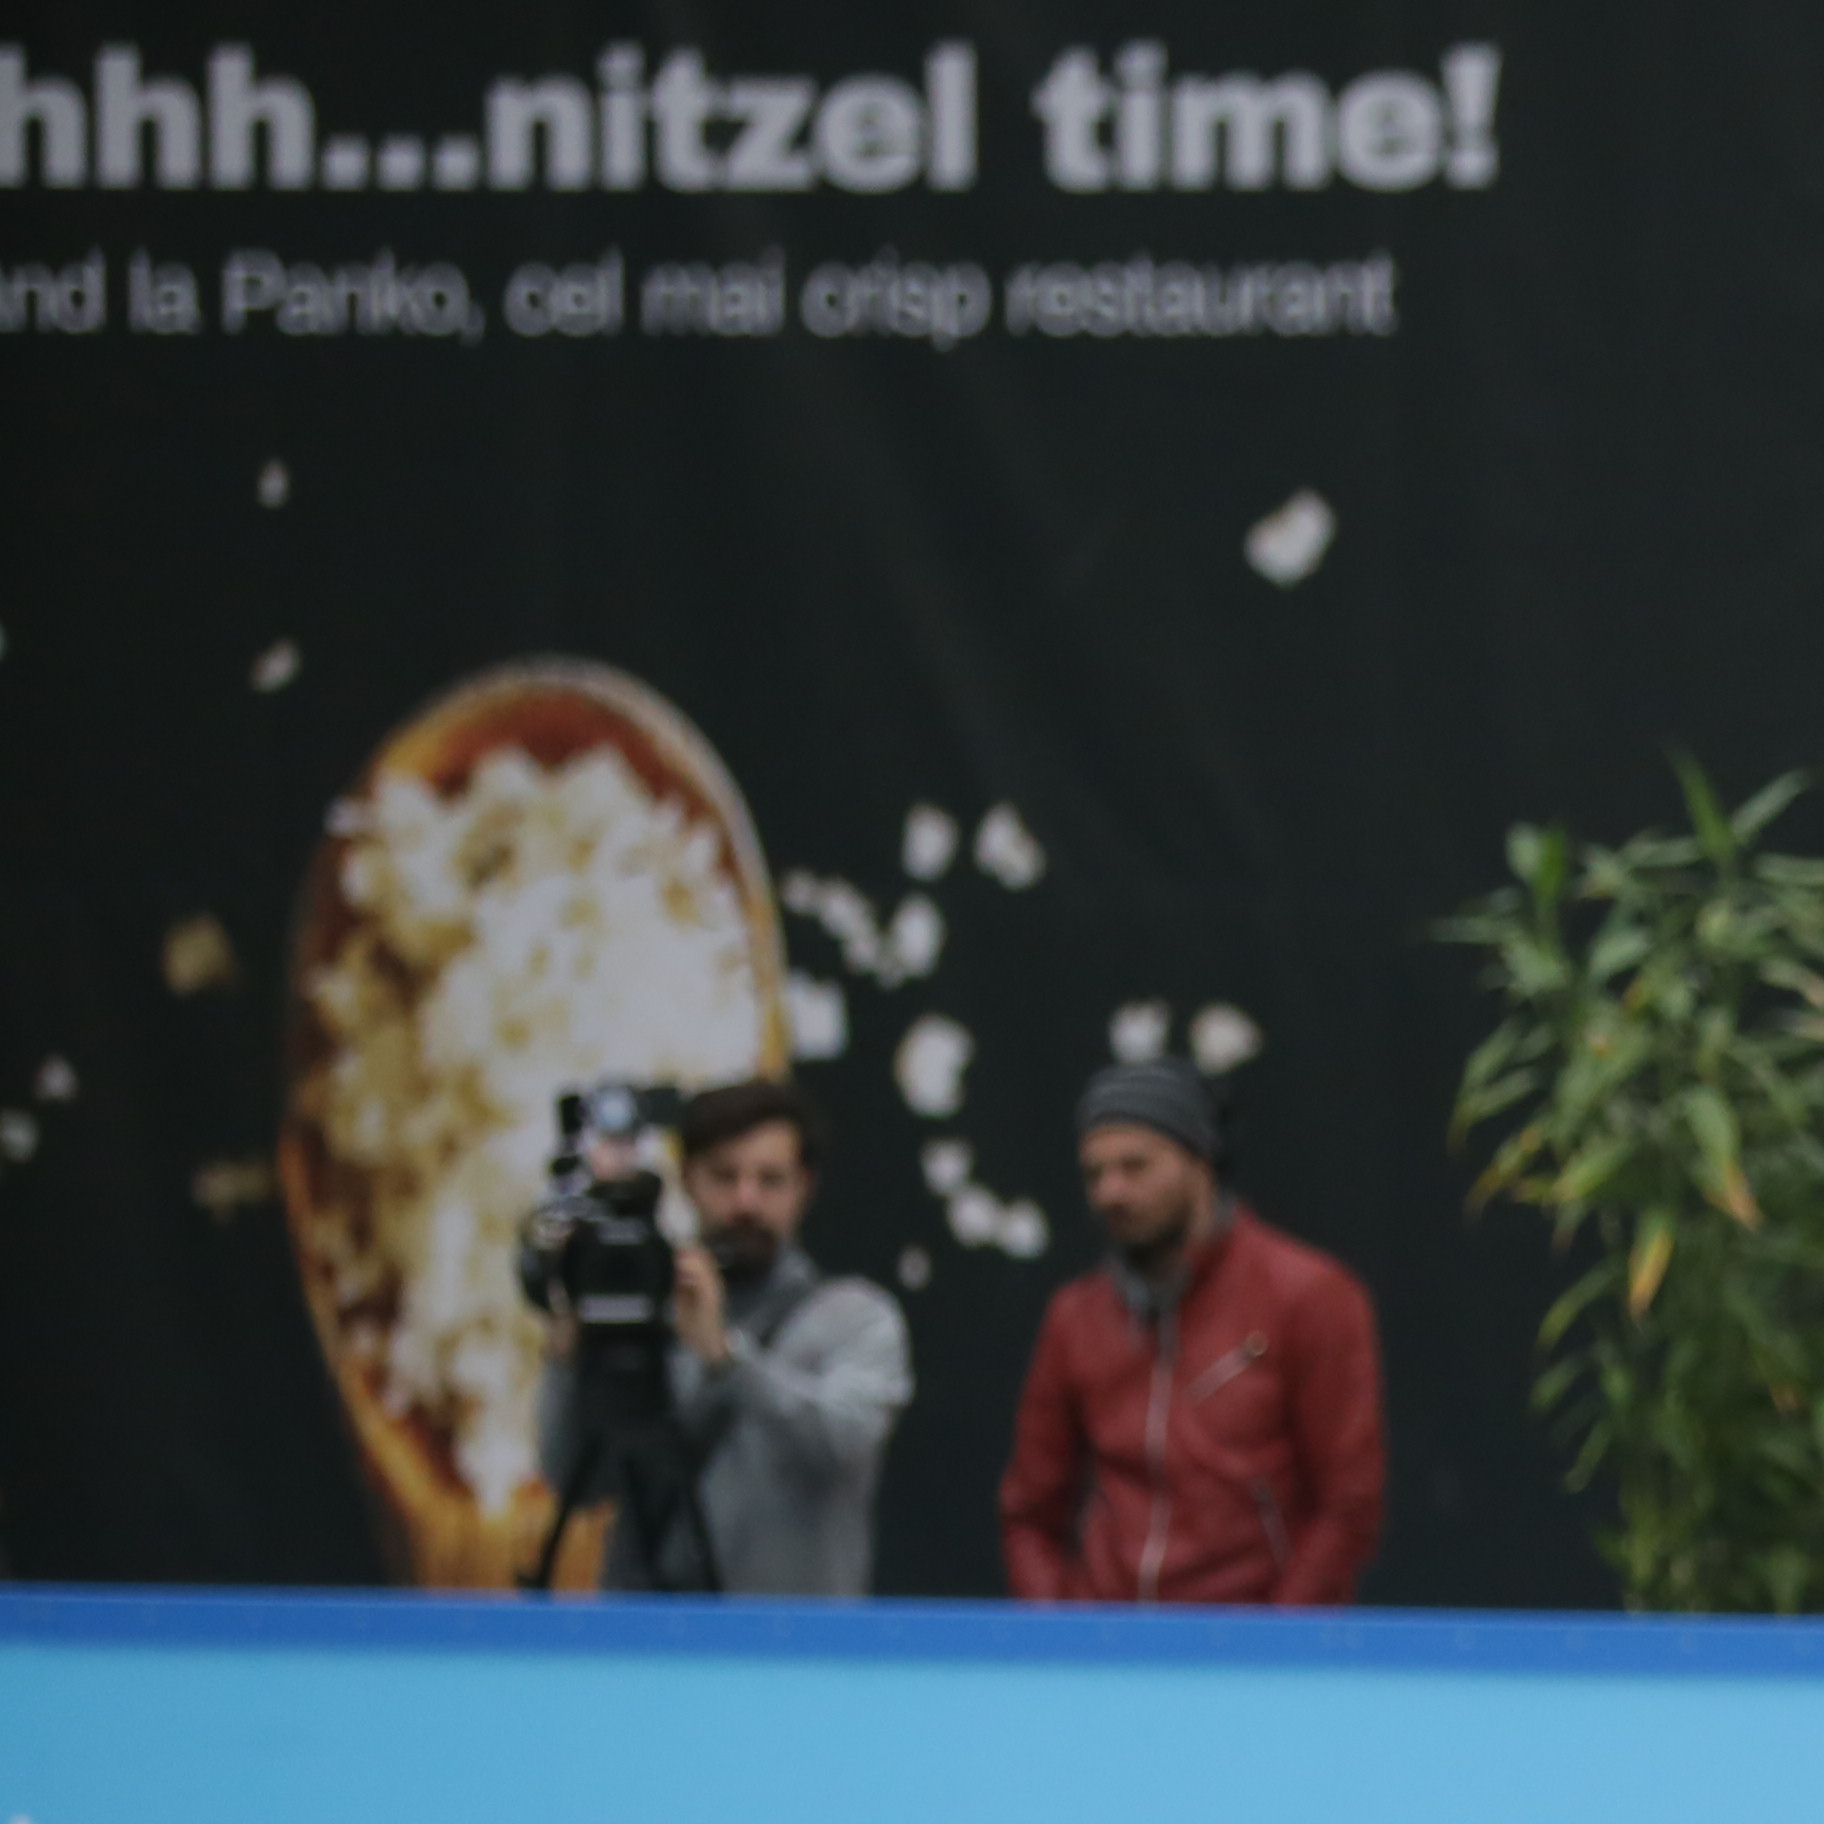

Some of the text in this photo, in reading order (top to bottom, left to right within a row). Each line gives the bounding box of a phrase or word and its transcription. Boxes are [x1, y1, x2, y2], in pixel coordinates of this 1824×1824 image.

[1030, 42, 1499, 191] time!
[128, 247, 199, 334] la
[222, 248, 485, 346] Panko,
[505, 246, 624, 337] cel
[640, 246, 786, 337] mai
[802, 246, 992, 350] crisp
[1005, 250, 1397, 337] restaurant
